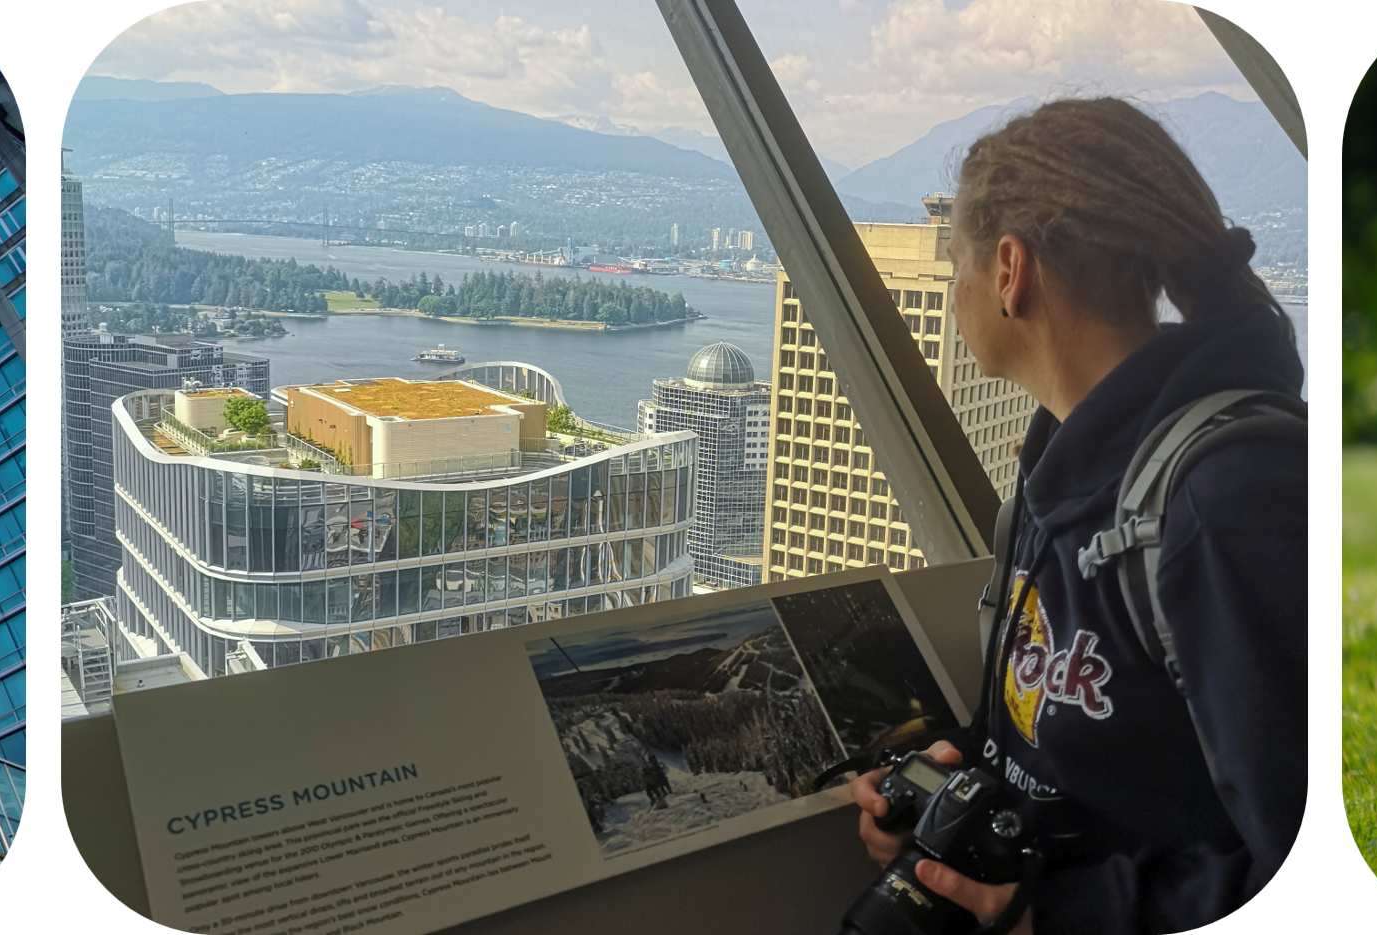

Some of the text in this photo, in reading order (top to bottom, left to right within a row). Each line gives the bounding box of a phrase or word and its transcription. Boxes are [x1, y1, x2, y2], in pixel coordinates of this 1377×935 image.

[167, 763, 418, 835] CYPRESS MOUNTAIN
[174, 846, 209, 861] Cypress
[210, 836, 250, 852] Mountain
[251, 829, 280, 843] towers
[281, 823, 306, 835] above
[306, 816, 328, 829] West
[328, 807, 369, 823] Vancouver
[370, 802, 385, 813] and
[393, 796, 415, 807] home
[424, 785, 457, 800] Canada's
[457, 780, 475, 791] most
[244, 858, 269, 871] venue
[270, 854, 283, 864] for
[284, 850, 298, 860] the
[300, 843, 319, 857] 2010
[320, 836, 353, 851] Olympic
[362, 823, 404, 840] Paralympic
[432, 808, 463, 822] Offering
[469, 796, 508, 813] spectacular
[285, 836, 303, 846] This
[303, 825, 342, 844] provincial
[343, 821, 361, 834] park
[362, 817, 377, 828] was
[377, 814, 391, 824] the
[417, 799, 451, 813] Freestyle
[474, 789, 488, 800] and
[230, 876, 250, 888] view
[262, 869, 277, 879] the
[278, 858, 318, 875] expansive
[319, 851, 344, 865] Lower
[345, 841, 380, 857] Mainland
[401, 829, 431, 843] Cypress
[430, 820, 465, 834] Mountain
[482, 805, 518, 821] immensely
[266, 902, 288, 914] drive
[289, 895, 310, 907] from
[310, 883, 353, 902] downtown
[397, 868, 410, 878] the
[411, 861, 435, 874] winter
[436, 854, 460, 867] sports
[514, 833, 530, 845] itself
[221, 891, 241, 904] spot
[273, 877, 294, 890] local
[253, 918, 275, 932] most
[277, 909, 308, 925] vertical
[353, 892, 368, 904] and
[369, 882, 404, 899] broadest
[404, 875, 430, 889] terrain
[430, 870, 444, 881] out
[454, 865, 468, 875] any
[468, 854, 502, 870] mountain
[510, 849, 522, 859] the
[337, 909, 356, 922] best
[357, 904, 378, 916] snow
[421, 882, 452, 897] Cypress
[452, 872, 486, 887] Mountain
[499, 859, 530, 874] between
[530, 852, 552, 864] Mount
[342, 920, 365, 934] Black
